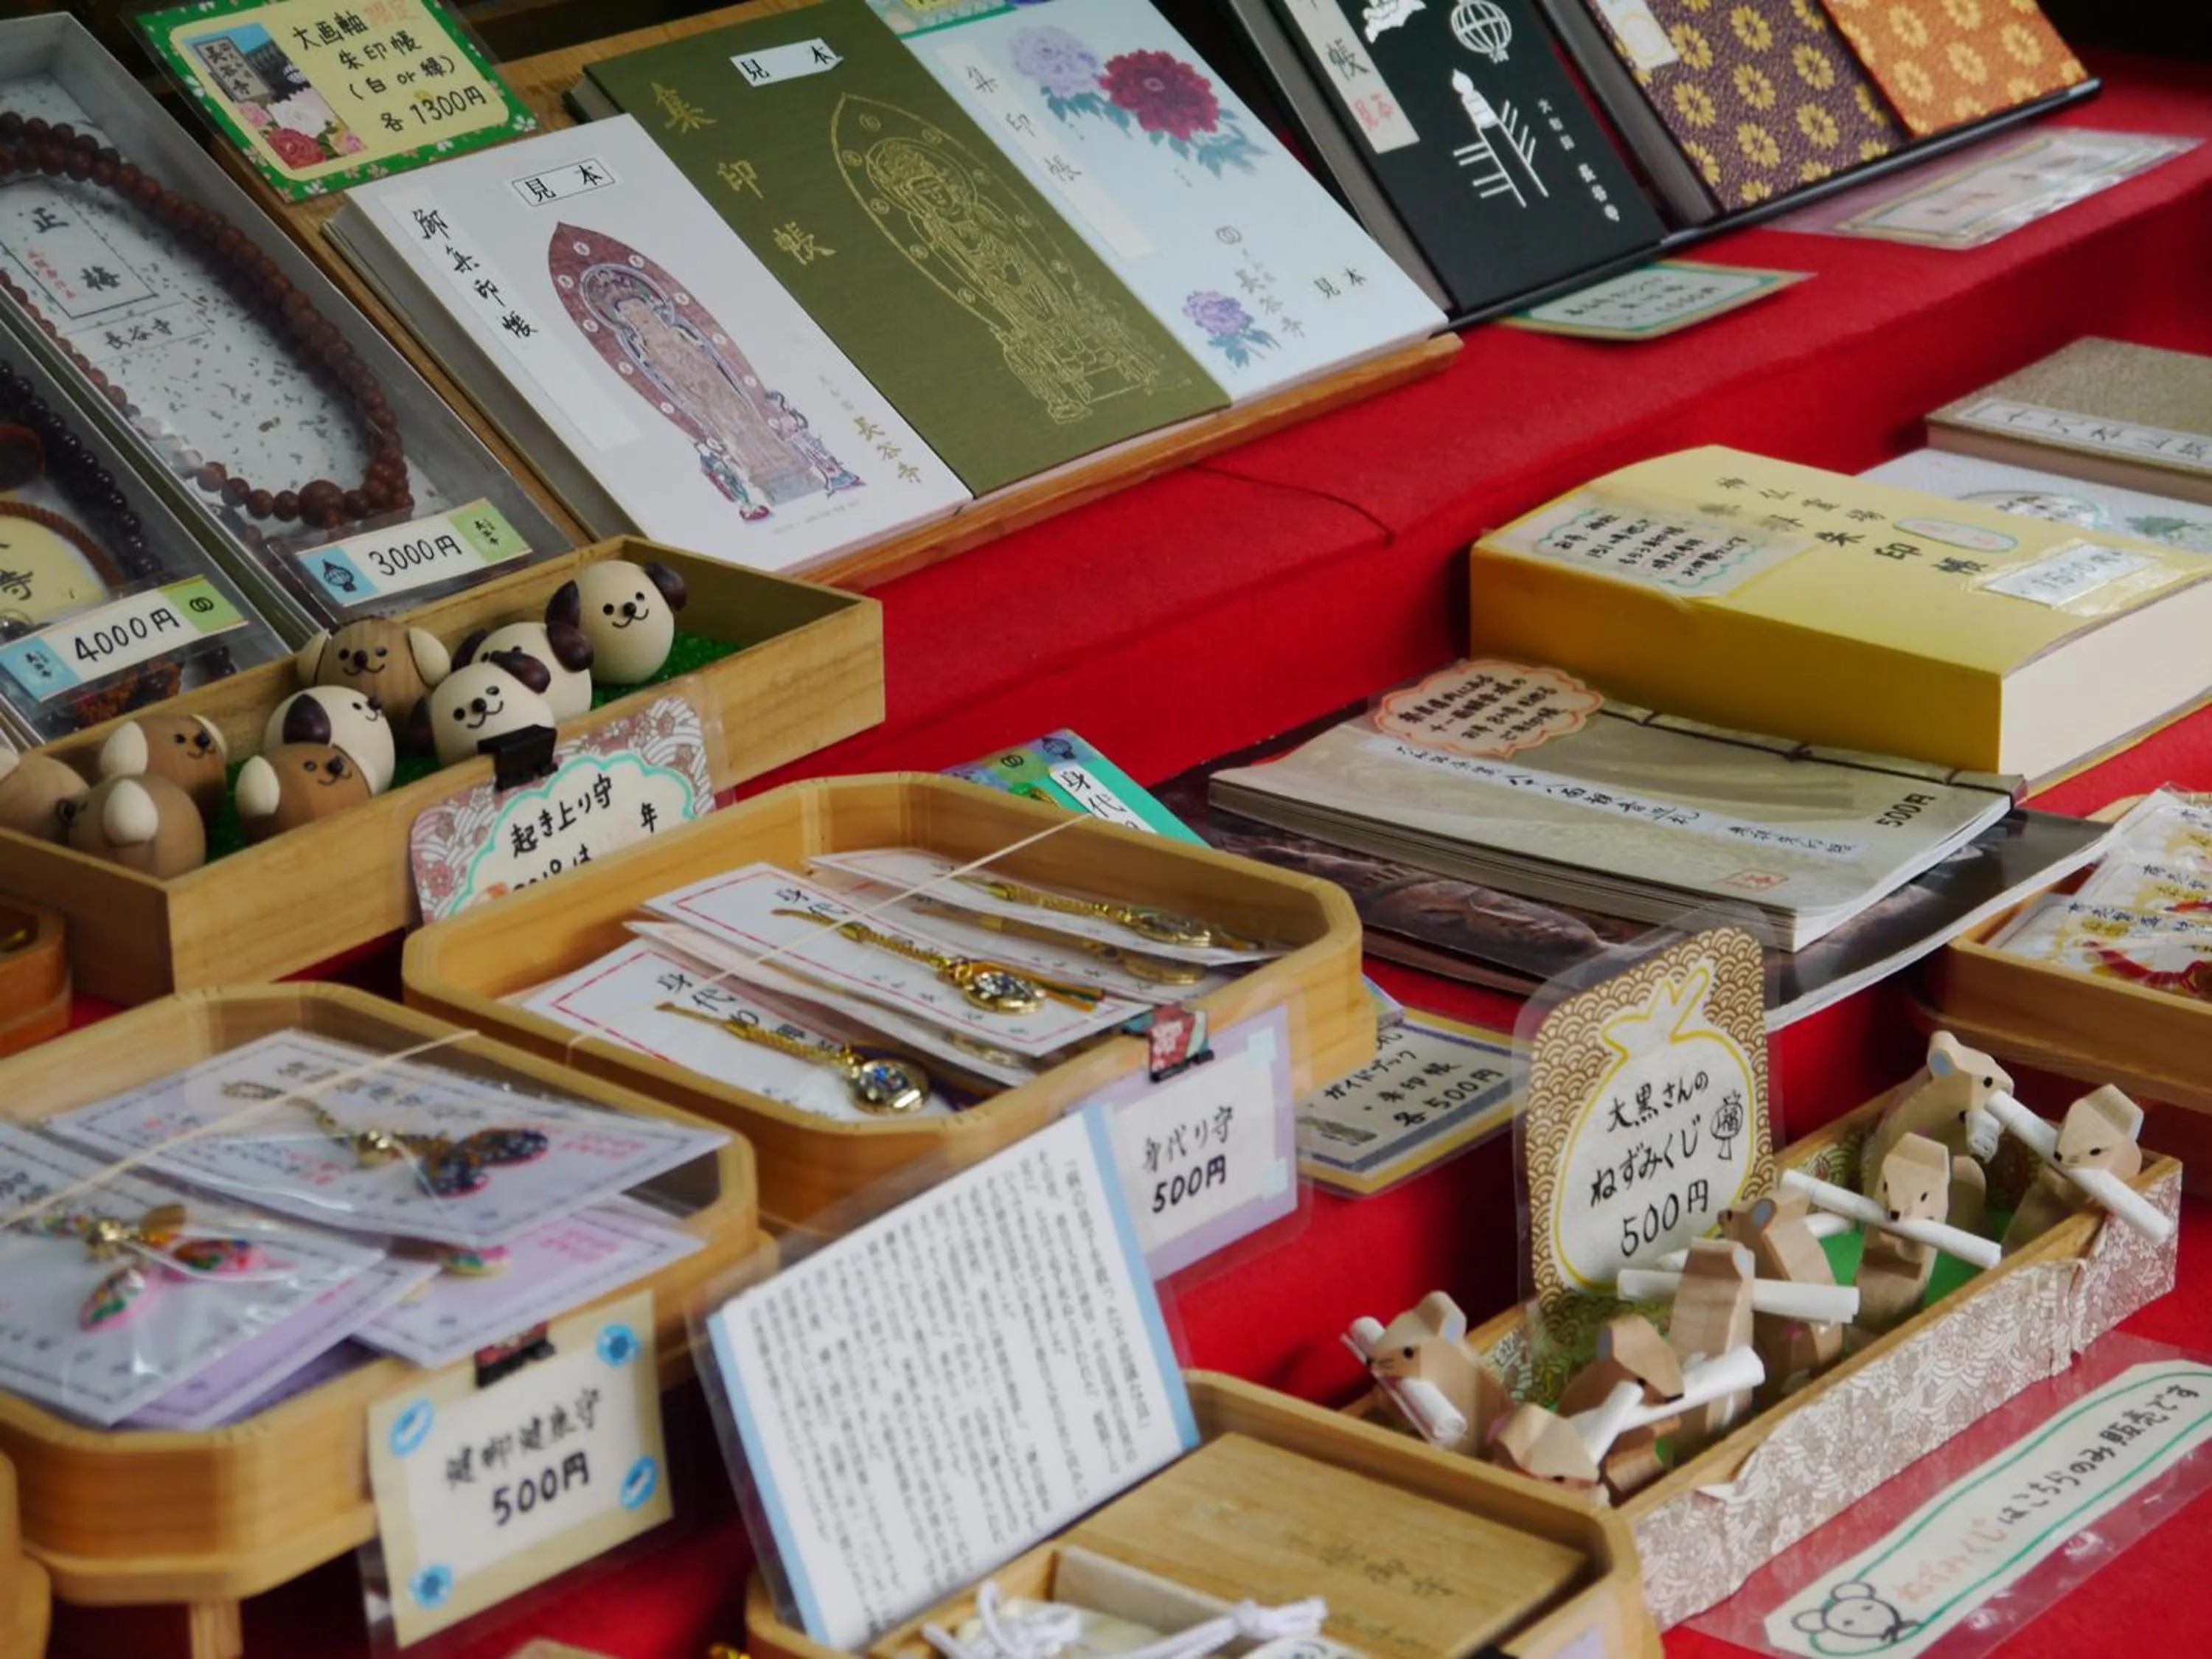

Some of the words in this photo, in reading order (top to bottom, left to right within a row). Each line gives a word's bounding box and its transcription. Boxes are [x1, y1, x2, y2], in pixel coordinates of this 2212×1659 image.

[293, 10, 368, 50] 大画軸
[338, 30, 422, 70] 朱印帳
[740, 46, 834, 81] 見本
[409, 85, 487, 125] 1300円
[525, 164, 603, 202] 見本
[1313, 267, 1368, 301] 見本
[369, 535, 462, 576] 3000円
[74, 608, 181, 662] 4000円
[511, 772, 612, 859] 起き上り守
[640, 801, 658, 834] 年
[1875, 793, 1937, 827] 500円
[1607, 1071, 1709, 1133] 大黒さんの
[1590, 1114, 1701, 1208] ねずみくじ
[1152, 1154, 1226, 1214] 500円
[1621, 1179, 1708, 1258] 500円
[492, 1451, 590, 1527] 500円
